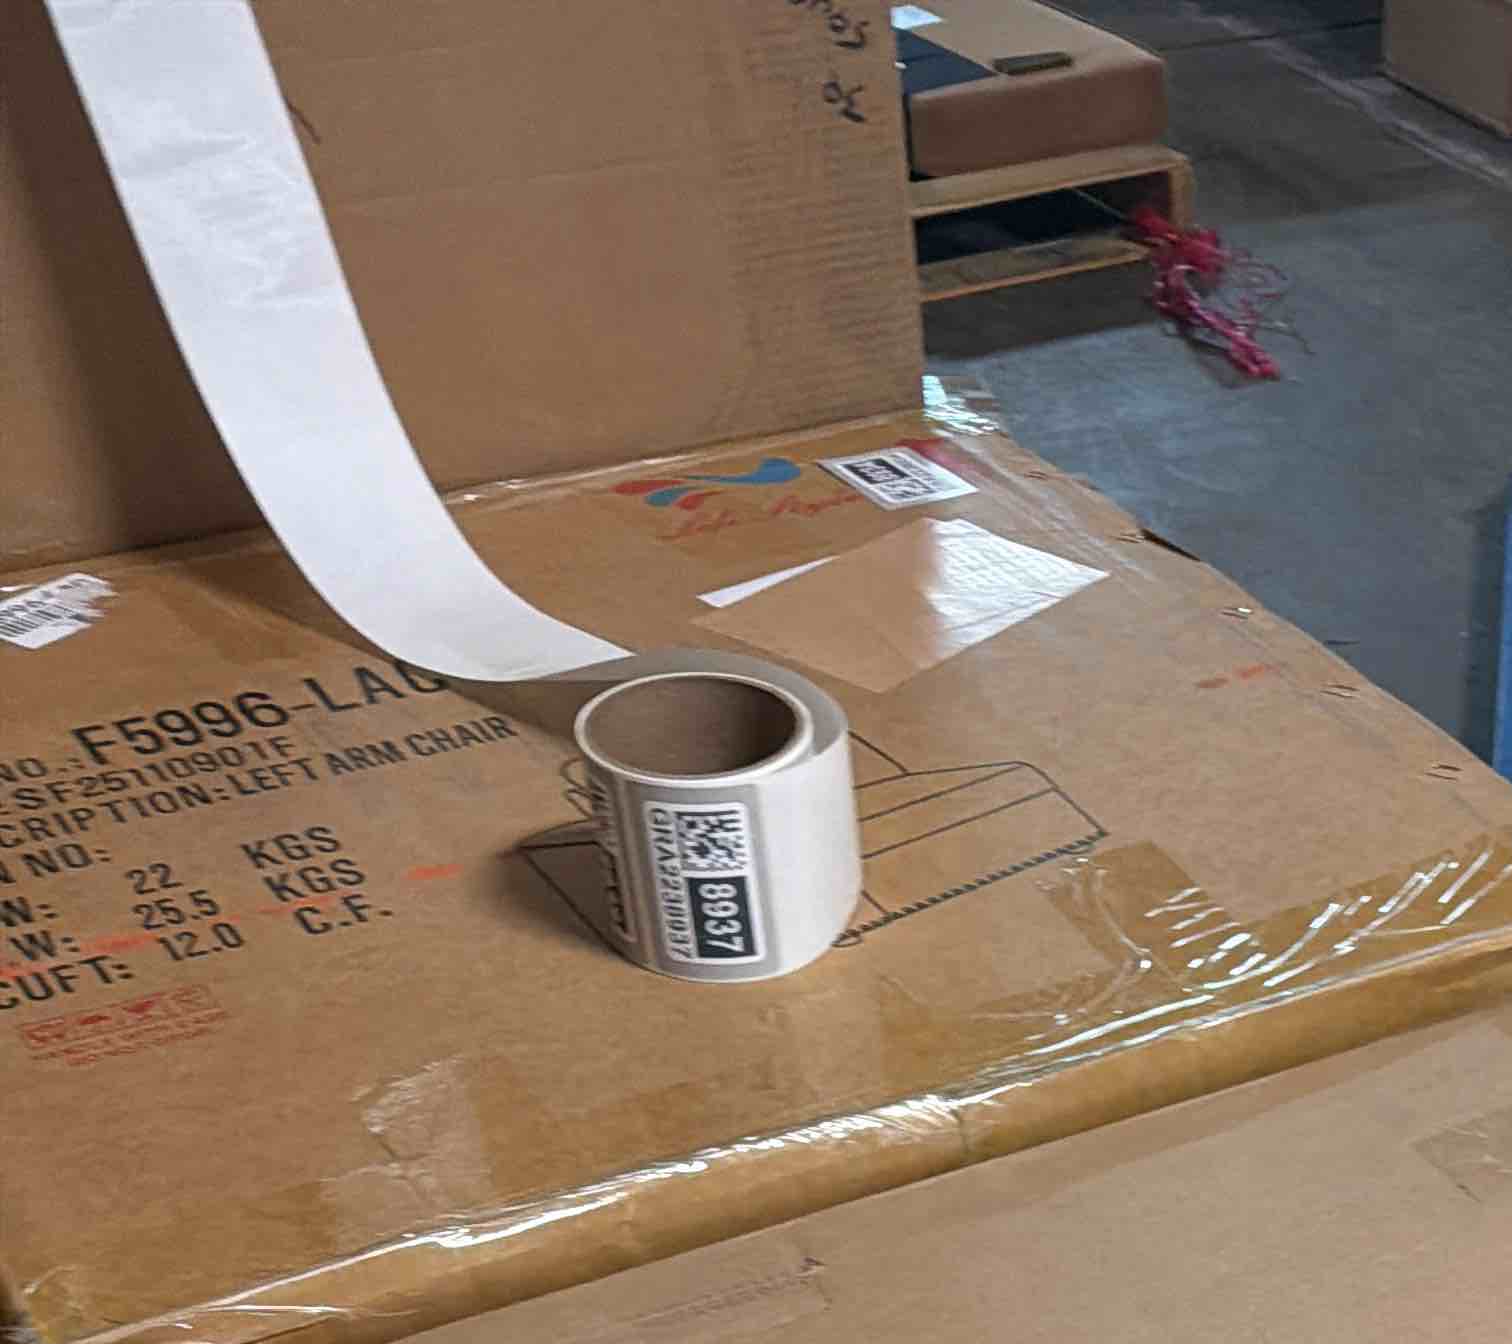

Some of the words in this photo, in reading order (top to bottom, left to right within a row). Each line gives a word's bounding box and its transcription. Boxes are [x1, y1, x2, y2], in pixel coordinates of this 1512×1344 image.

[323, 740, 408, 776] ARM
[405, 716, 518, 757] CHAIR
[126, 862, 183, 895] 22
[241, 826, 341, 869] KGS
[132, 889, 220, 931] 25.5
[263, 858, 366, 903] KGS
[157, 922, 245, 961] 12.0
[698, 883, 746, 953] 8937
